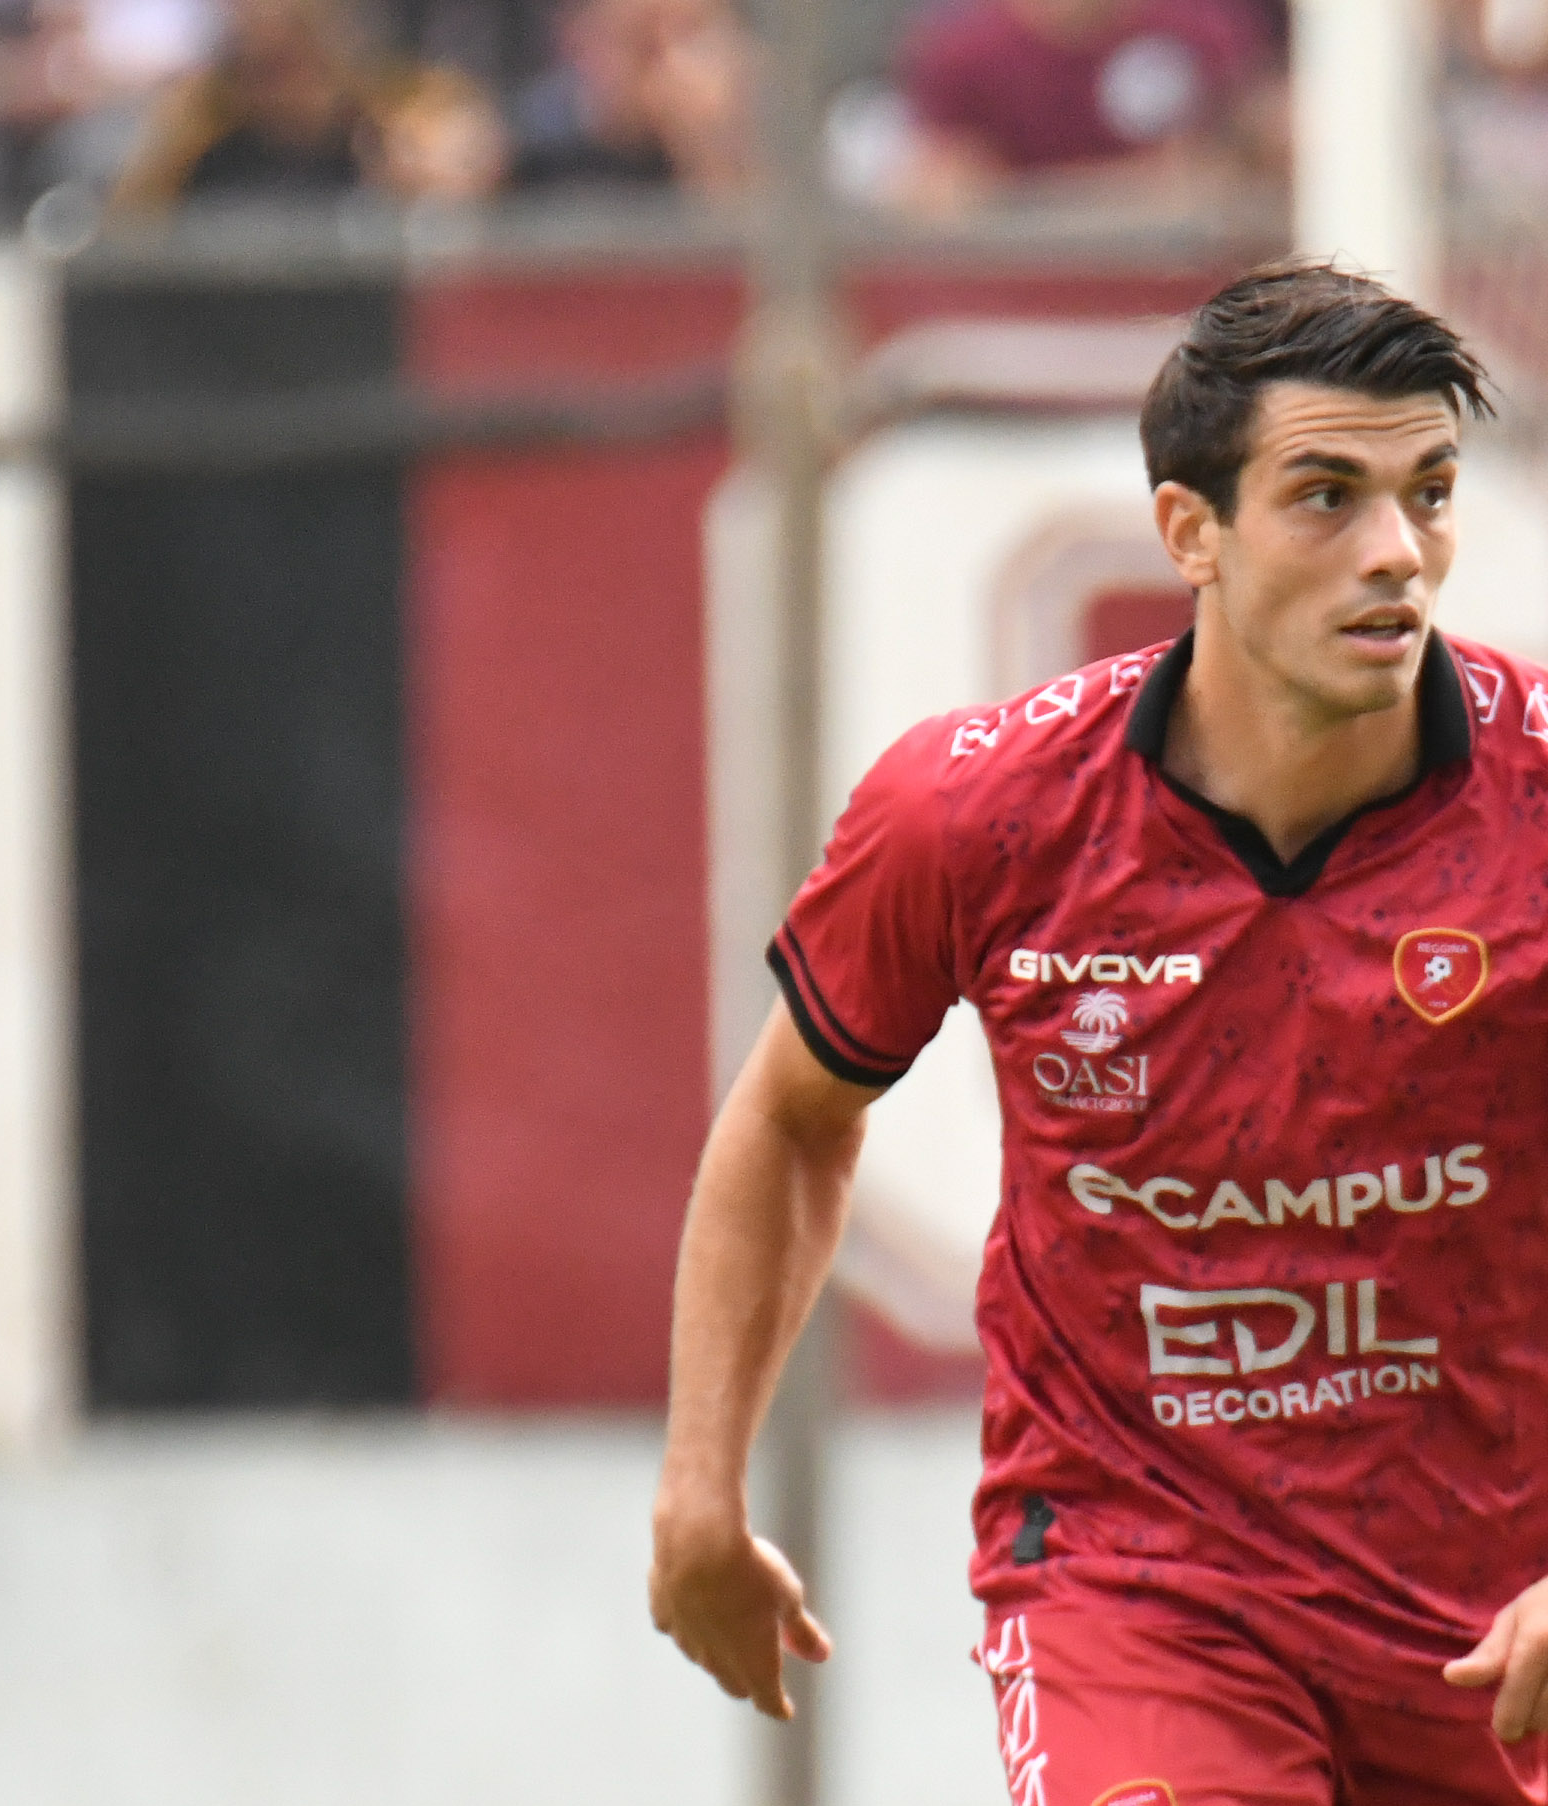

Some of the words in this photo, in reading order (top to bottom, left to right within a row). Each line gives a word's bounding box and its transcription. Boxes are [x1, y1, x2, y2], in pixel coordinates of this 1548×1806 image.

[1009, 947, 1201, 984] GIVOVA
[1032, 1052, 1149, 1097] OASI
[1140, 1278, 1440, 1376] EDIL
[1153, 1362, 1440, 1427] DECORATION
